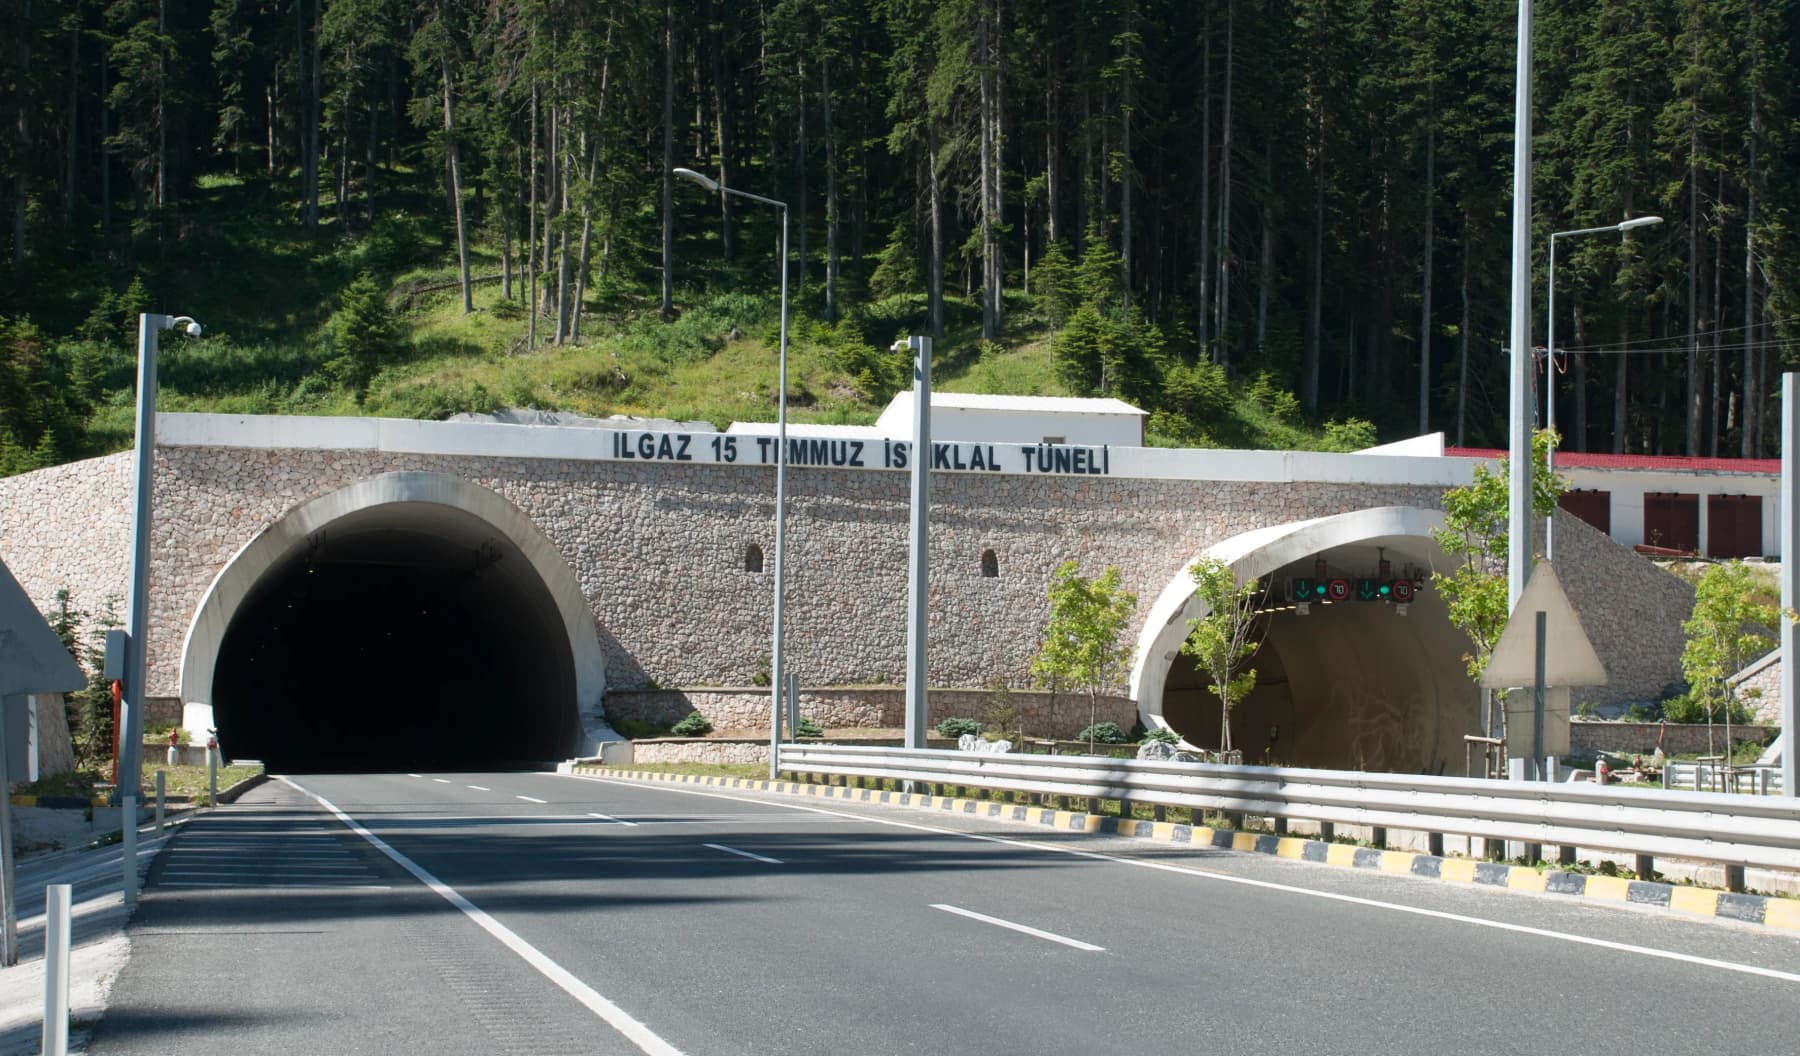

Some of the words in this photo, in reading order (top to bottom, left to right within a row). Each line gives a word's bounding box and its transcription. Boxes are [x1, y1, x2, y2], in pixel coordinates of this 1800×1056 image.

[614, 432, 692, 460] ILGAZ
[712, 436, 737, 462] 15
[885, 437, 1001, 471] İSKLAL
[1021, 443, 1109, 474] TÜNELİ
